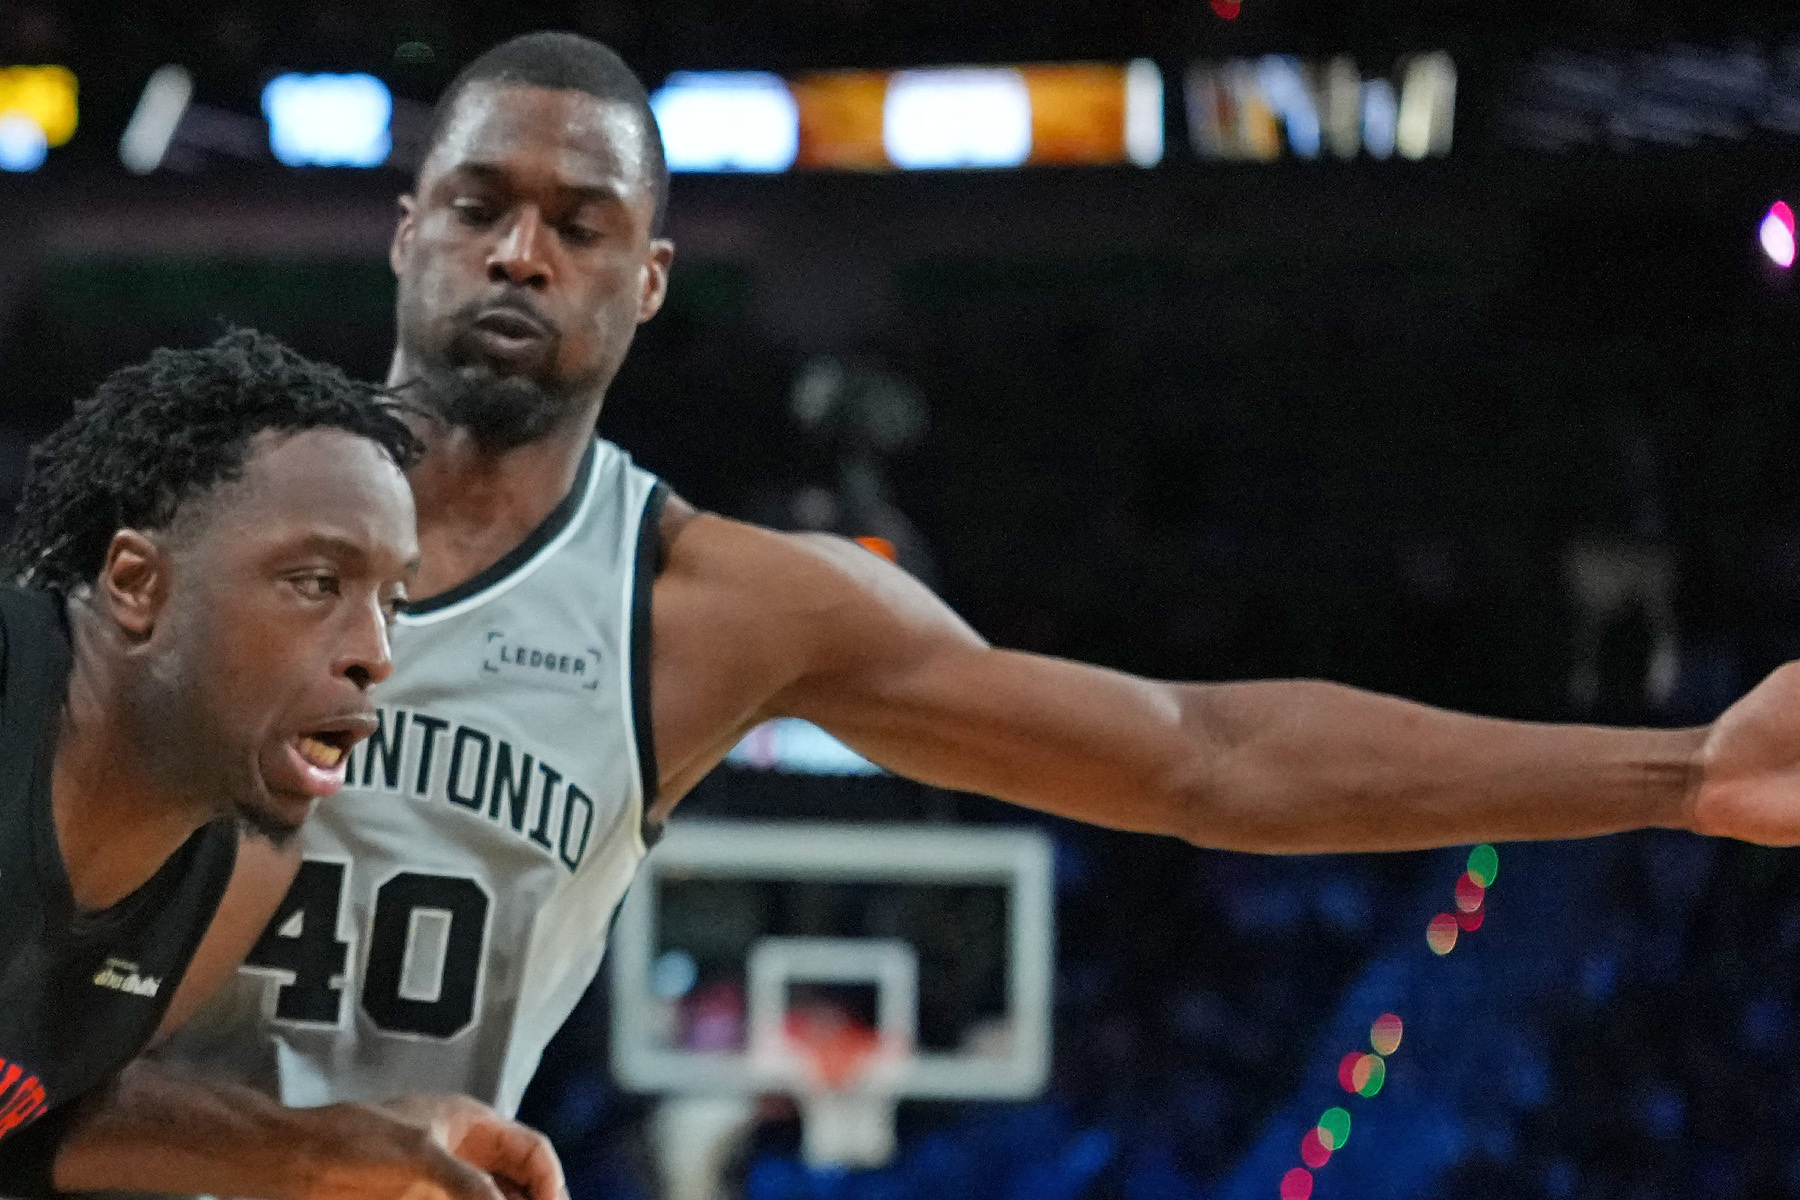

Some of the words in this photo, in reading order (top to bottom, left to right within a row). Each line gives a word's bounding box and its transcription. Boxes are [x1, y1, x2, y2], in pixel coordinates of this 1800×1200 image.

[500, 644, 586, 676] LEDGER
[344, 708, 596, 873] NTONIO
[242, 860, 493, 1040] 40
